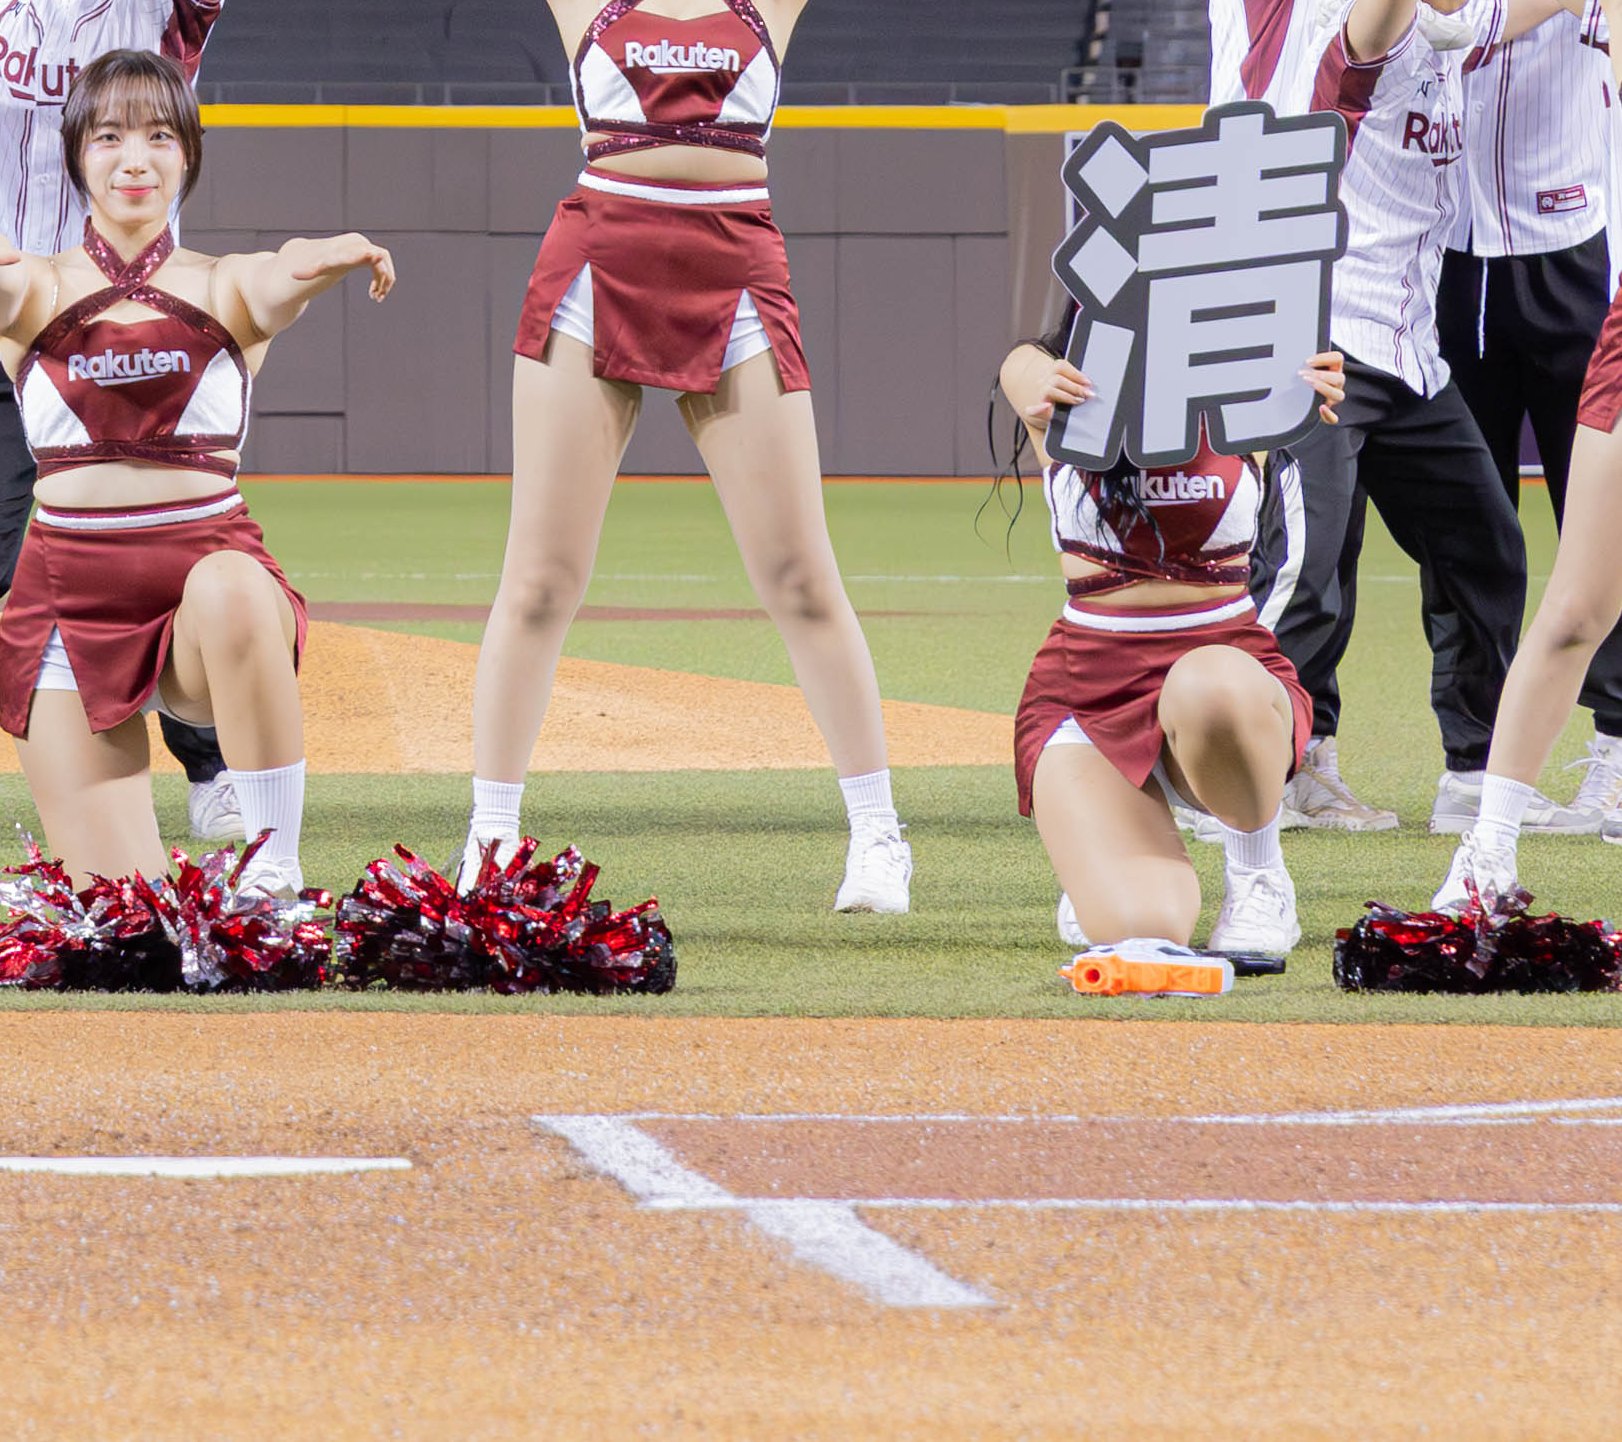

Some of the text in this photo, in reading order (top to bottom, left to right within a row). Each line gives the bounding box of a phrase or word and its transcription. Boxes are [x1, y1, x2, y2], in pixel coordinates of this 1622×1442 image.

[624, 38, 741, 75] Rakuten
[1059, 110, 1338, 460] 清
[67, 348, 191, 387] Rakuten
[1139, 469, 1226, 507] kuten
